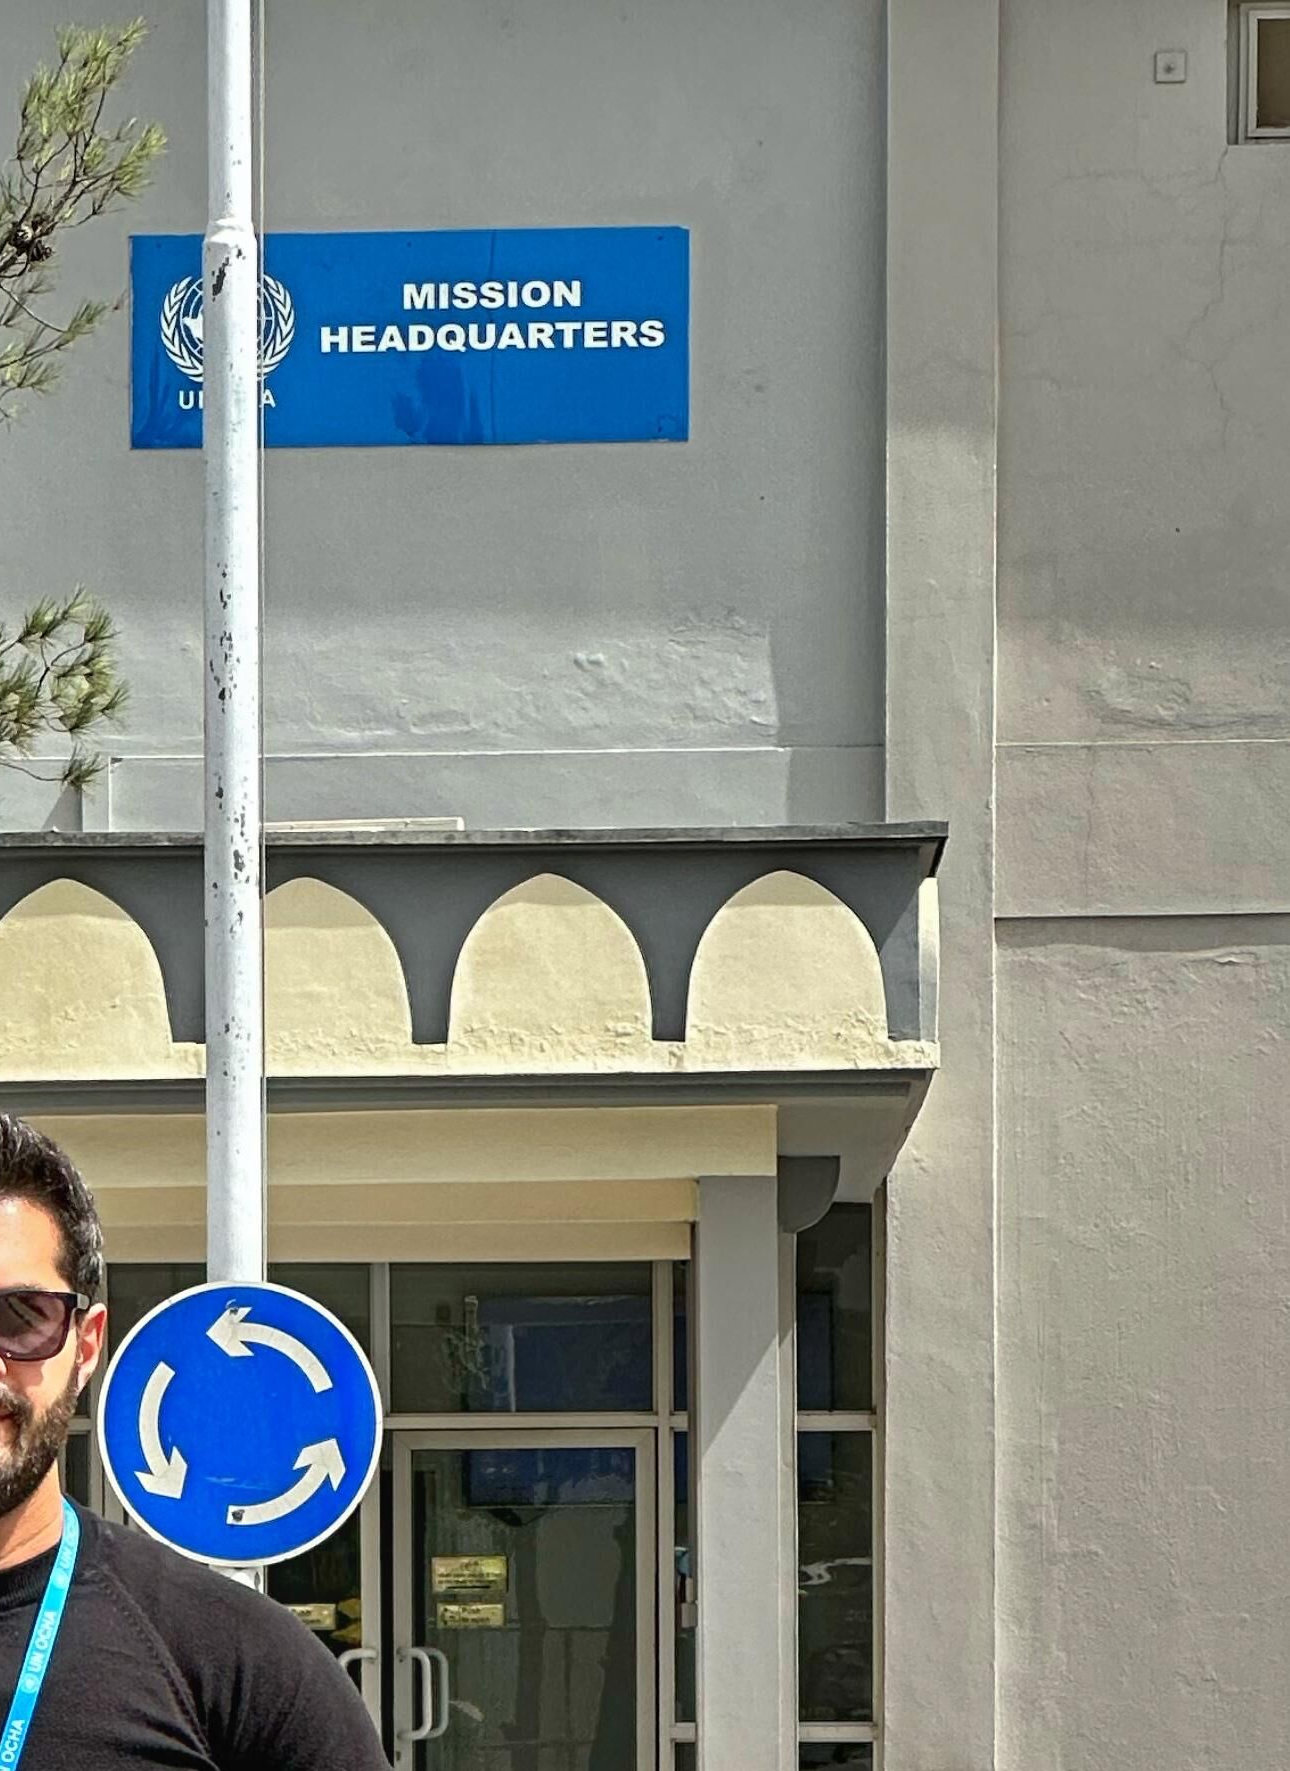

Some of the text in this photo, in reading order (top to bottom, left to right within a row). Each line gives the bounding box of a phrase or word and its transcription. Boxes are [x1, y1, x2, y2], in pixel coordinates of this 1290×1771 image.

[402, 279, 582, 310] MISSION
[320, 320, 666, 353] HEADQUARTERS
[27, 1611, 56, 1673] UN OCHA
[1, 1718, 25, 1763] OCHA
